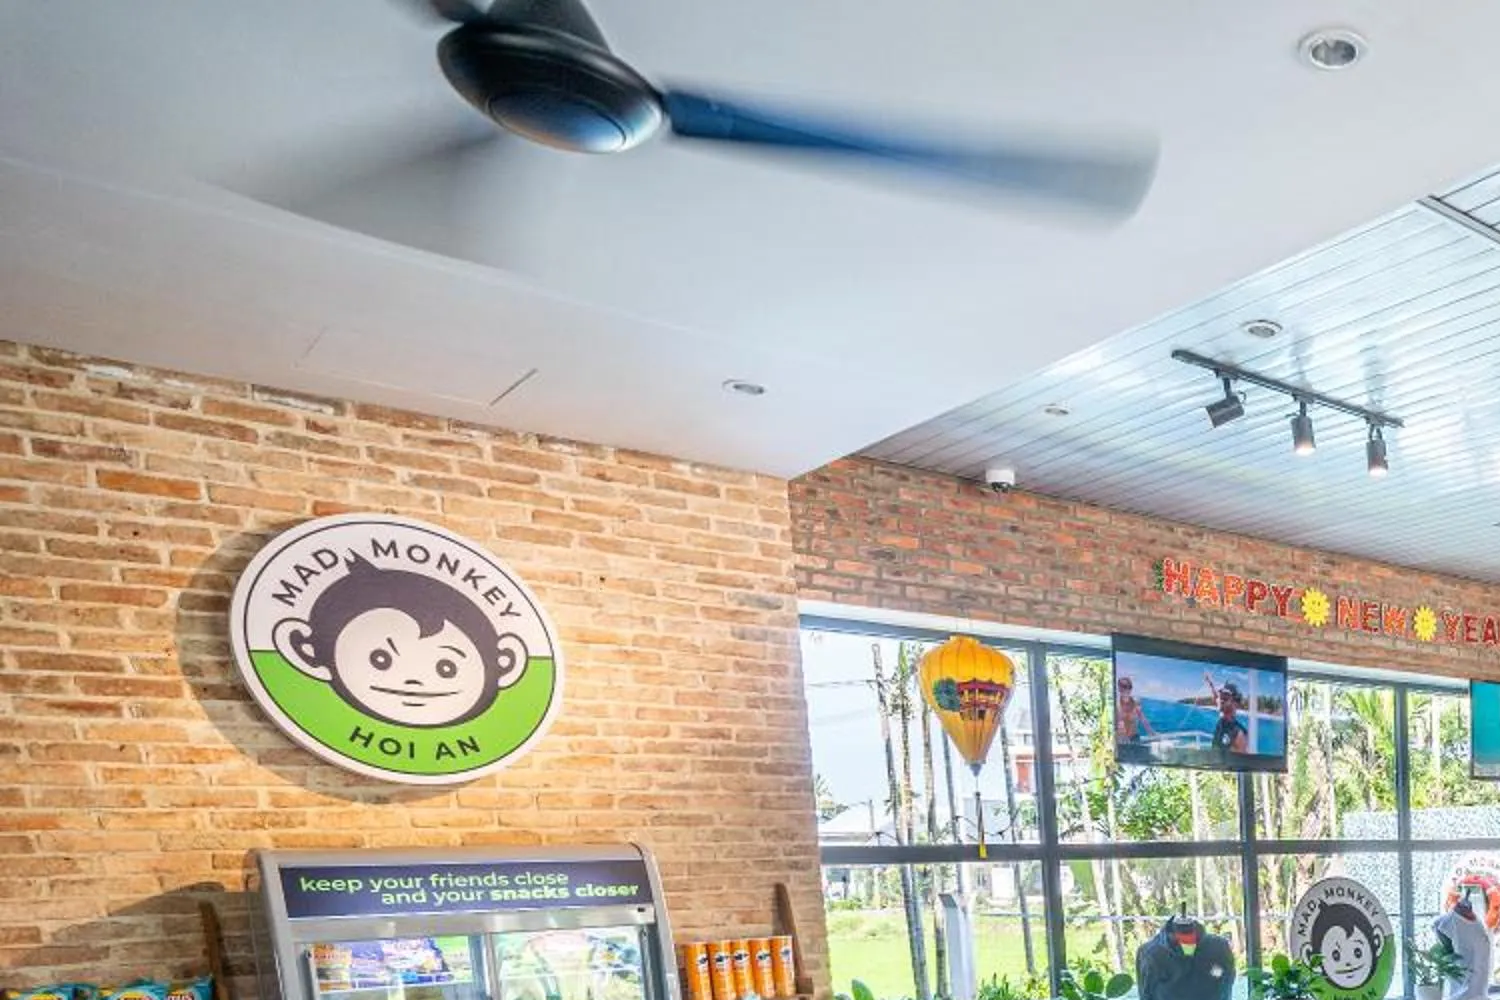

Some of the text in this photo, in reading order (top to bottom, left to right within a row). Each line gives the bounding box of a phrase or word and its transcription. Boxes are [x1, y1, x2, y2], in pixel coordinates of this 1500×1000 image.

[272, 538, 521, 620] MAD MONKEY
[1162, 558, 1294, 617] HAPPY
[1336, 595, 1407, 637] NEW
[349, 727, 480, 761] HOI AN
[300, 871, 569, 895] keep your friends close
[381, 883, 640, 906] and your snacks closer
[1298, 886, 1380, 936] MAD MONKEY
